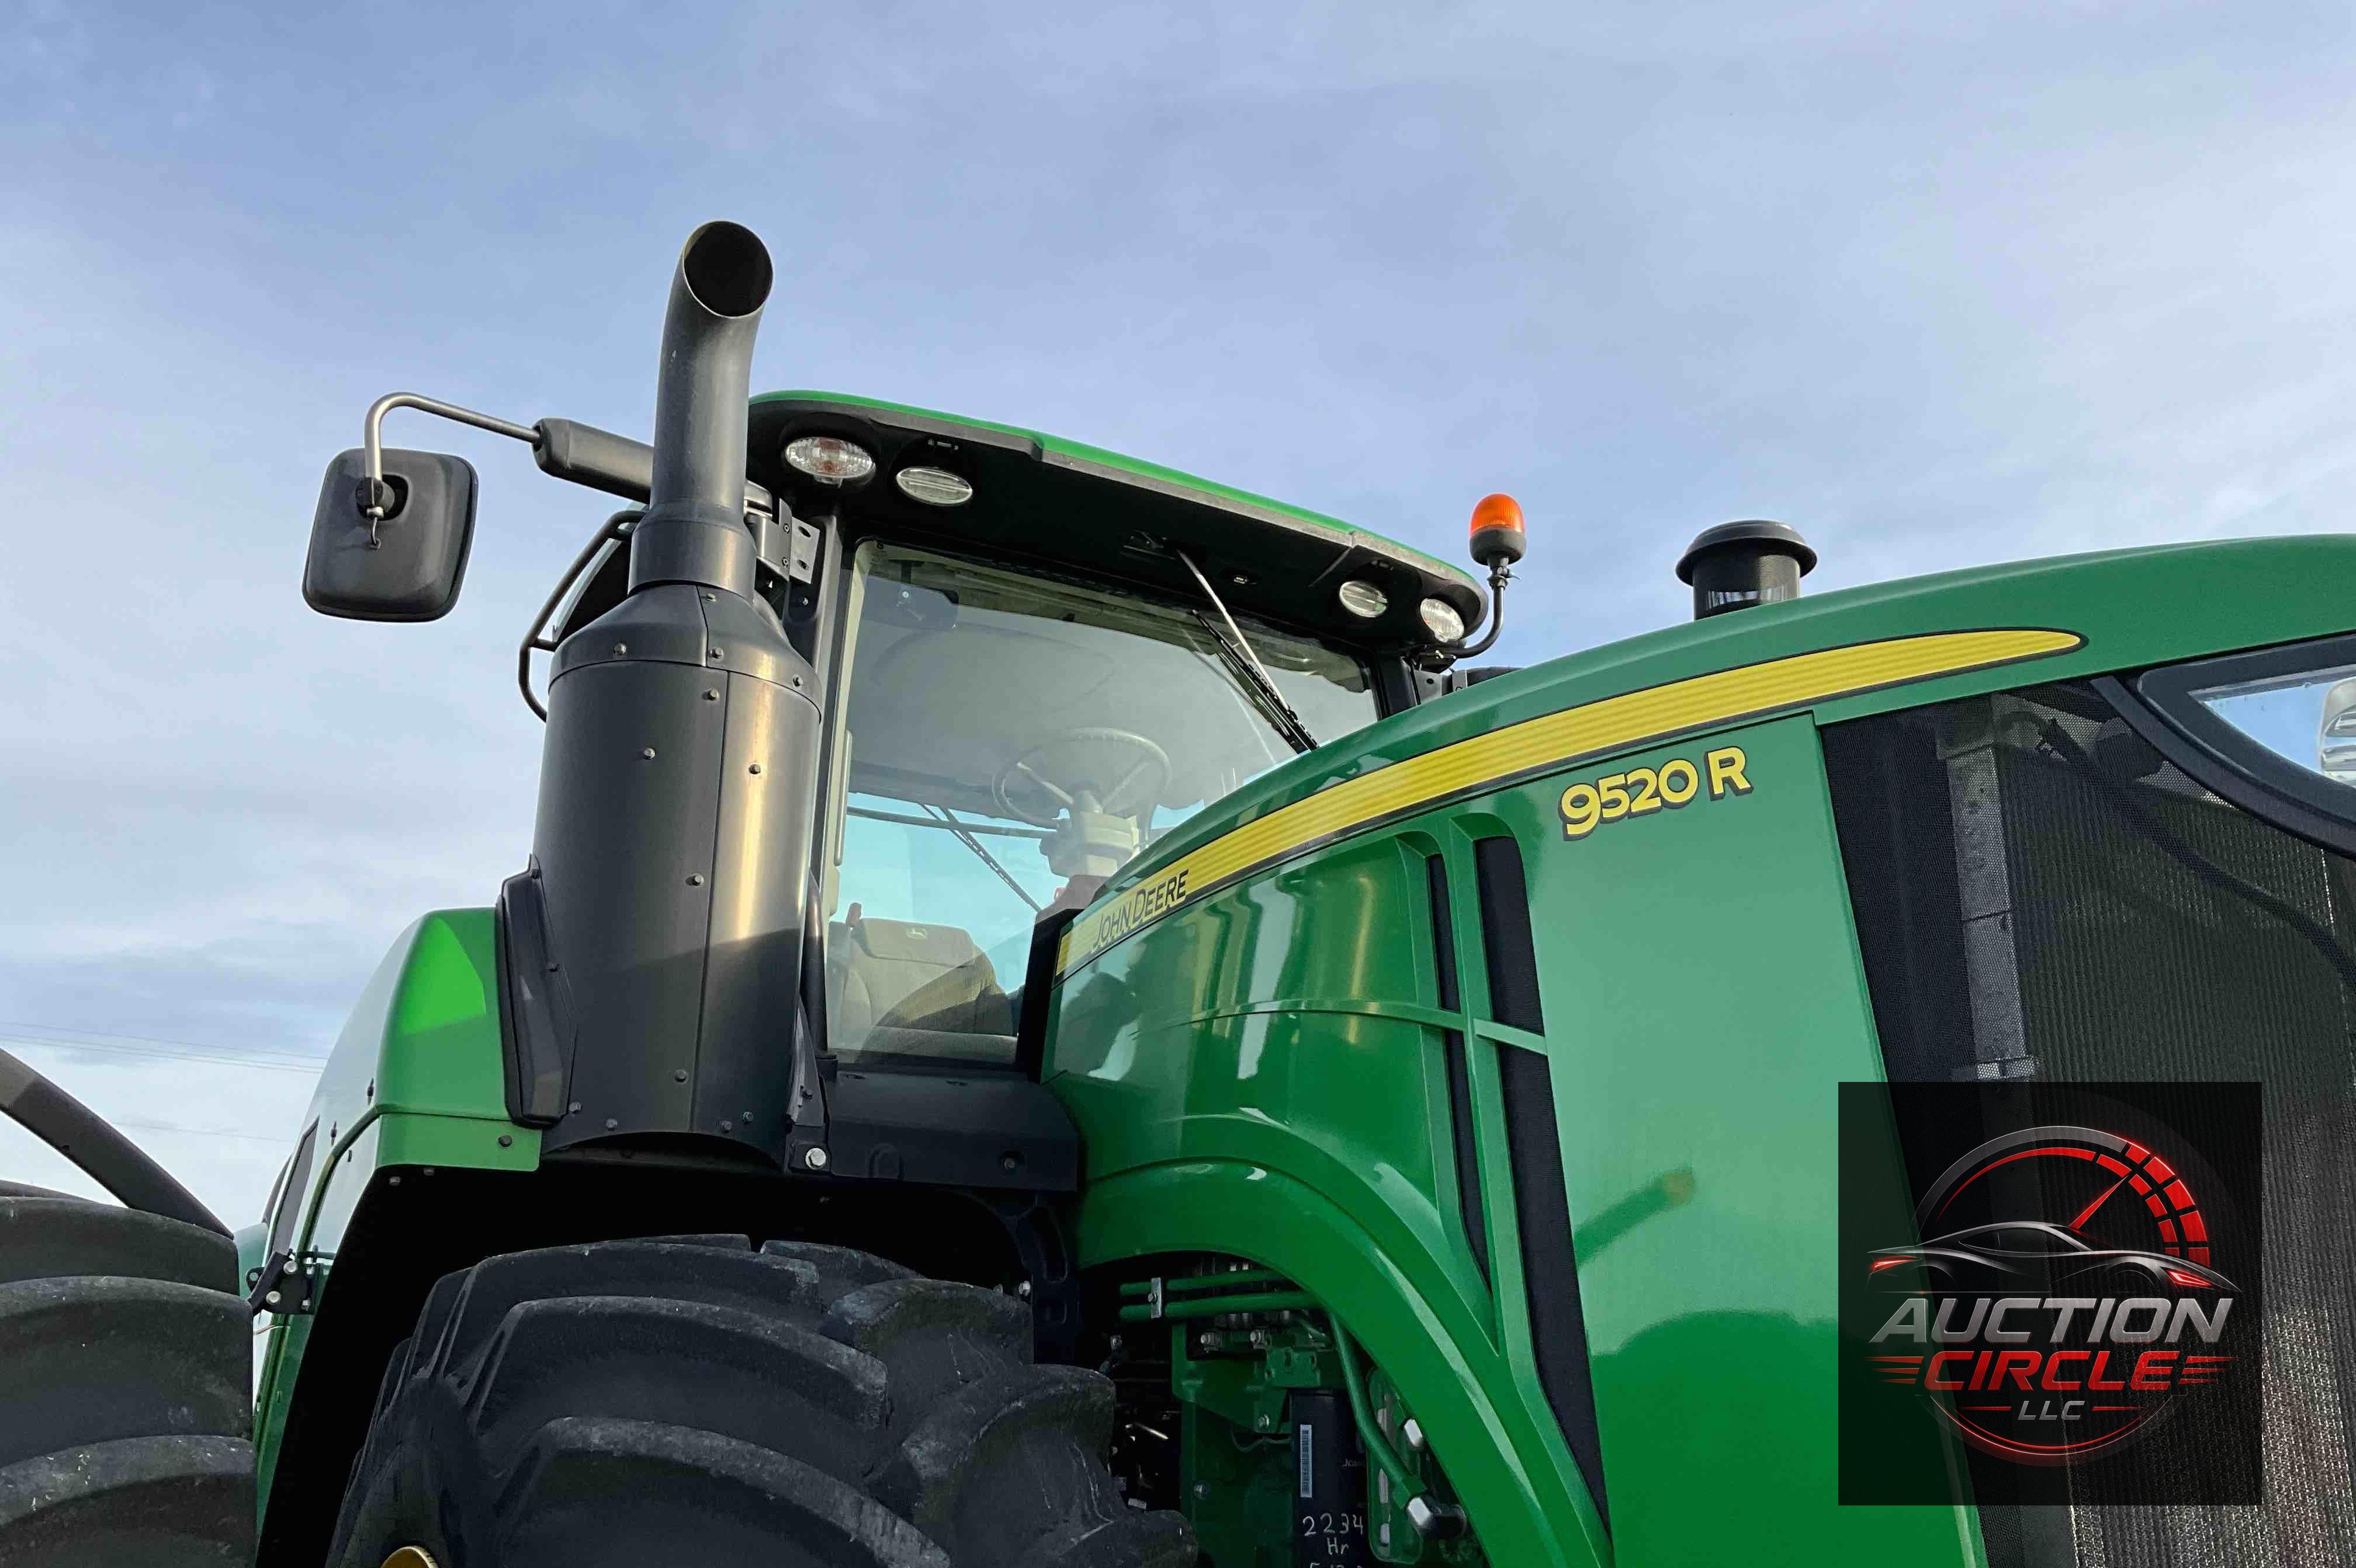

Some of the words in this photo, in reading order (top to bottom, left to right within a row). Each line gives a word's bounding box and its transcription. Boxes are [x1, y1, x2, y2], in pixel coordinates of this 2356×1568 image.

[1558, 758, 1699, 841] 9520
[1703, 745, 1753, 803] R
[1092, 901, 1132, 949] JOHN
[1131, 869, 1189, 924] DEERE
[1302, 1513, 1363, 1536] 2234
[1326, 1537, 1349, 1555] Hr
